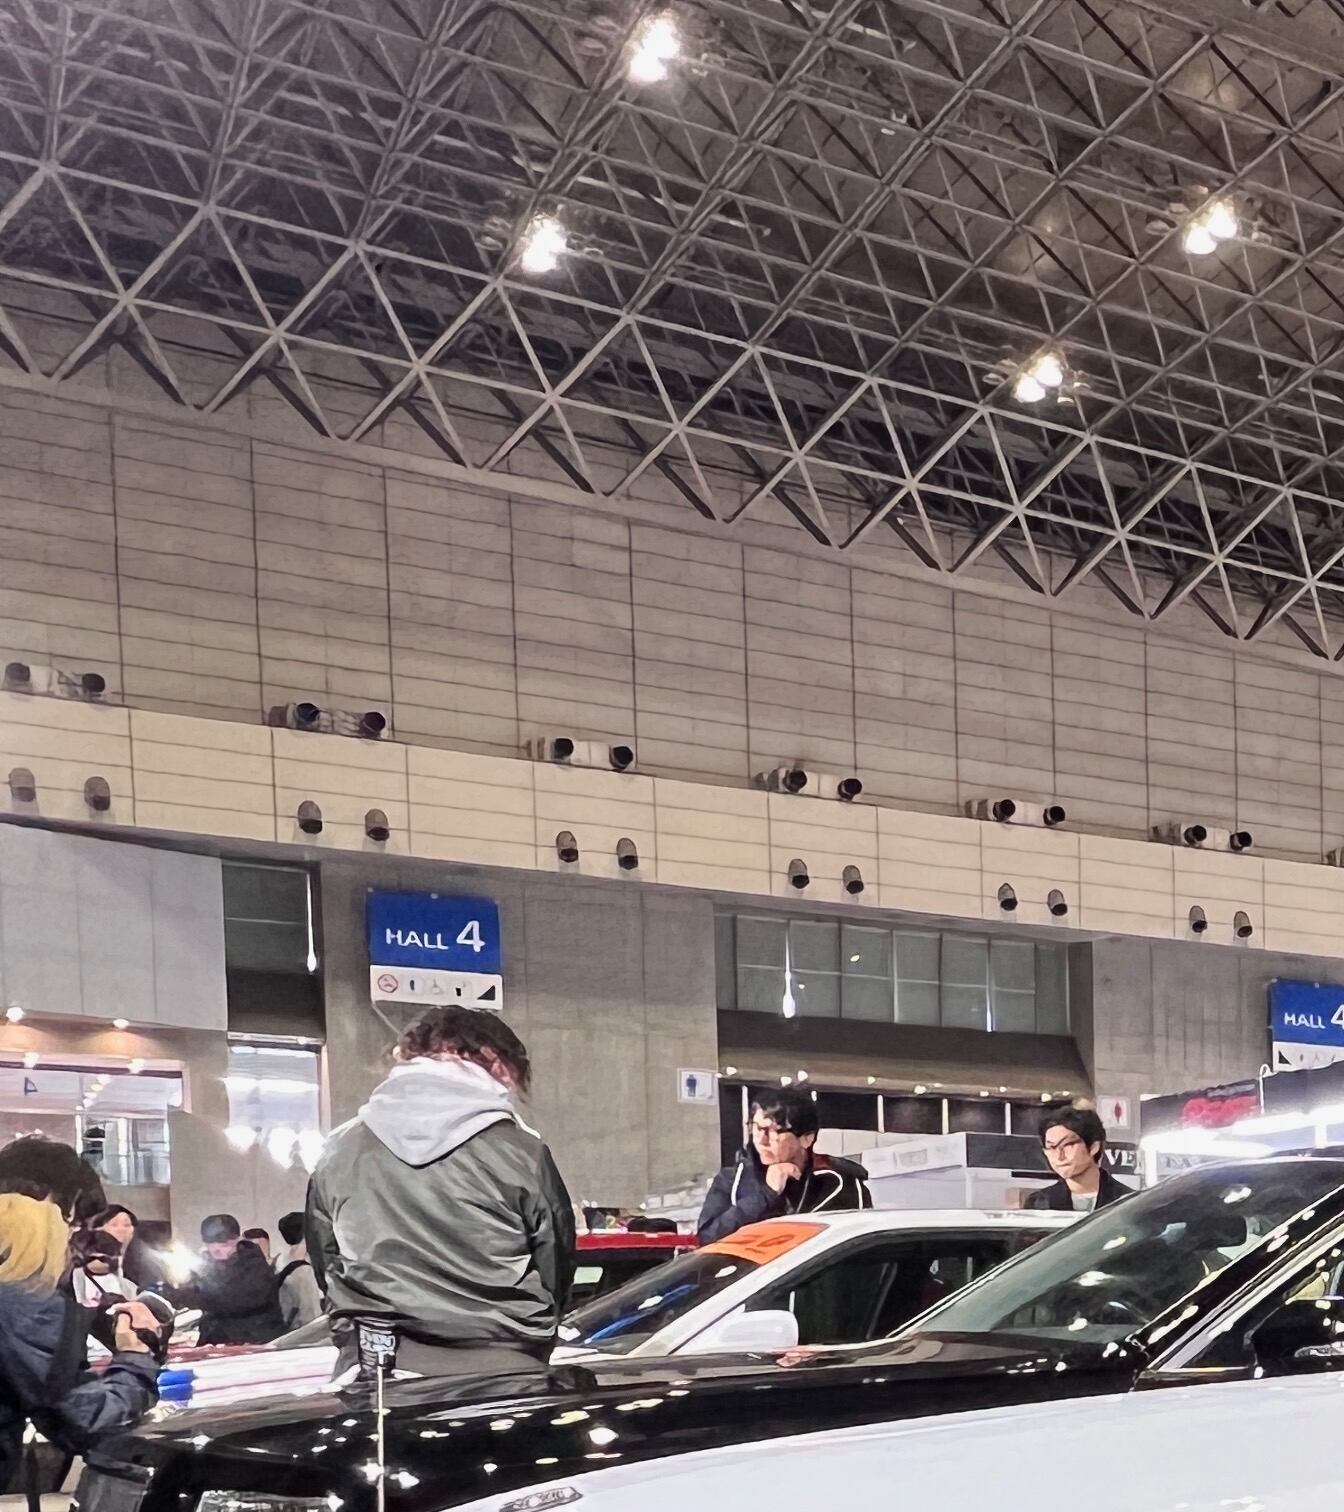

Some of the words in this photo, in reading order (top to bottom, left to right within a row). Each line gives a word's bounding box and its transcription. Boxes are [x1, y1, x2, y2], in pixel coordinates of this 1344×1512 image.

[385, 927, 449, 950] HALL
[456, 919, 486, 953] 4
[1283, 1011, 1327, 1030] HALL
